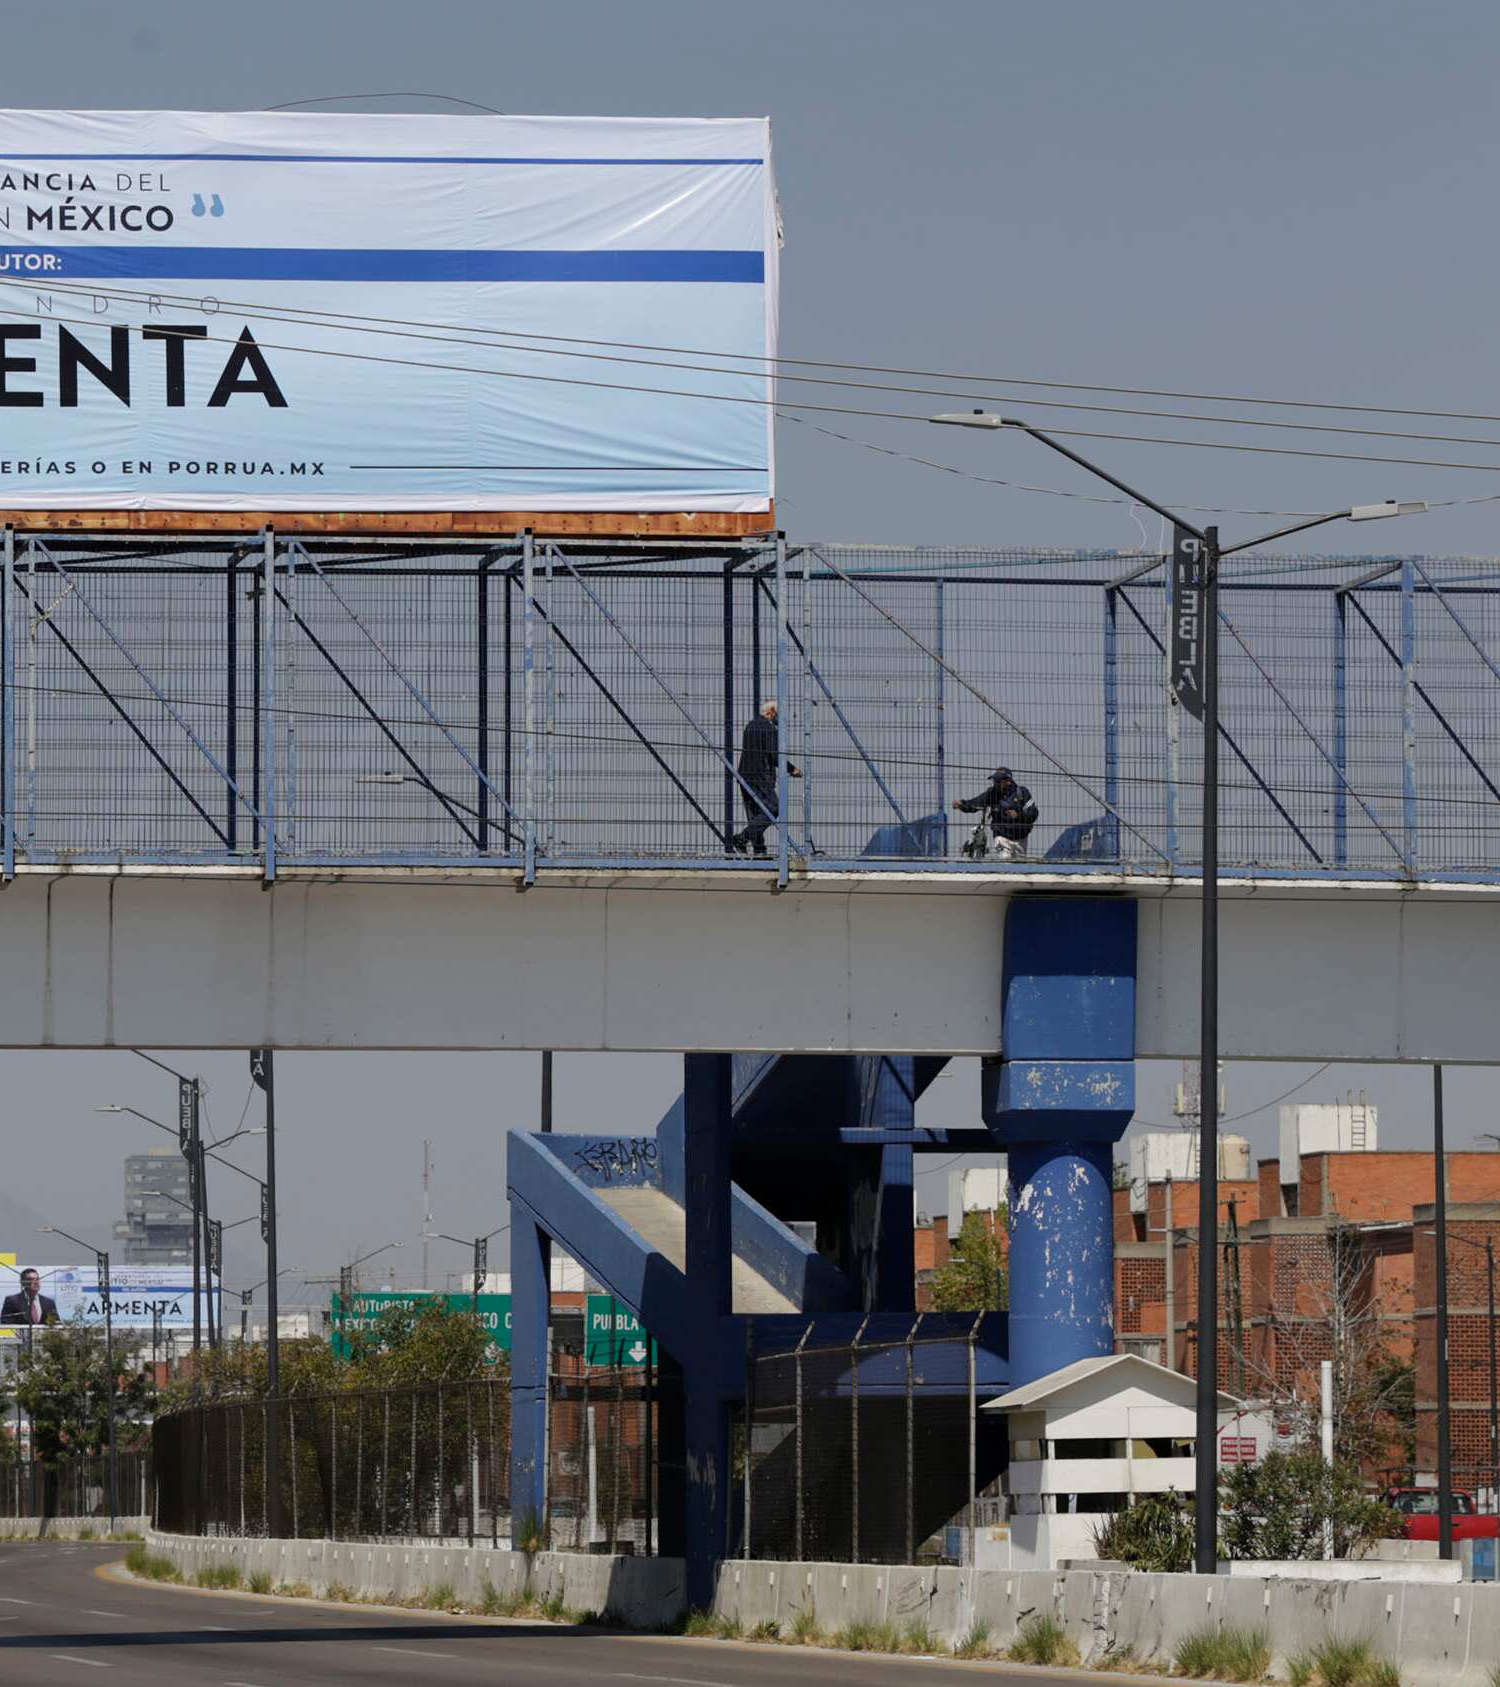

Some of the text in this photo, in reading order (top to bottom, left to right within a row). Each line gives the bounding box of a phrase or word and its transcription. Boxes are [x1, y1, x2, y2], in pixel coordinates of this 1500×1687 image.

[116, 173, 171, 192] DEL
[26, 197, 174, 232] MÉXICO
[91, 460, 107, 475] O
[121, 460, 153, 475] EN
[168, 461, 326, 476] PORRUA.MX
[87, 1300, 182, 1316] ARMENTA
